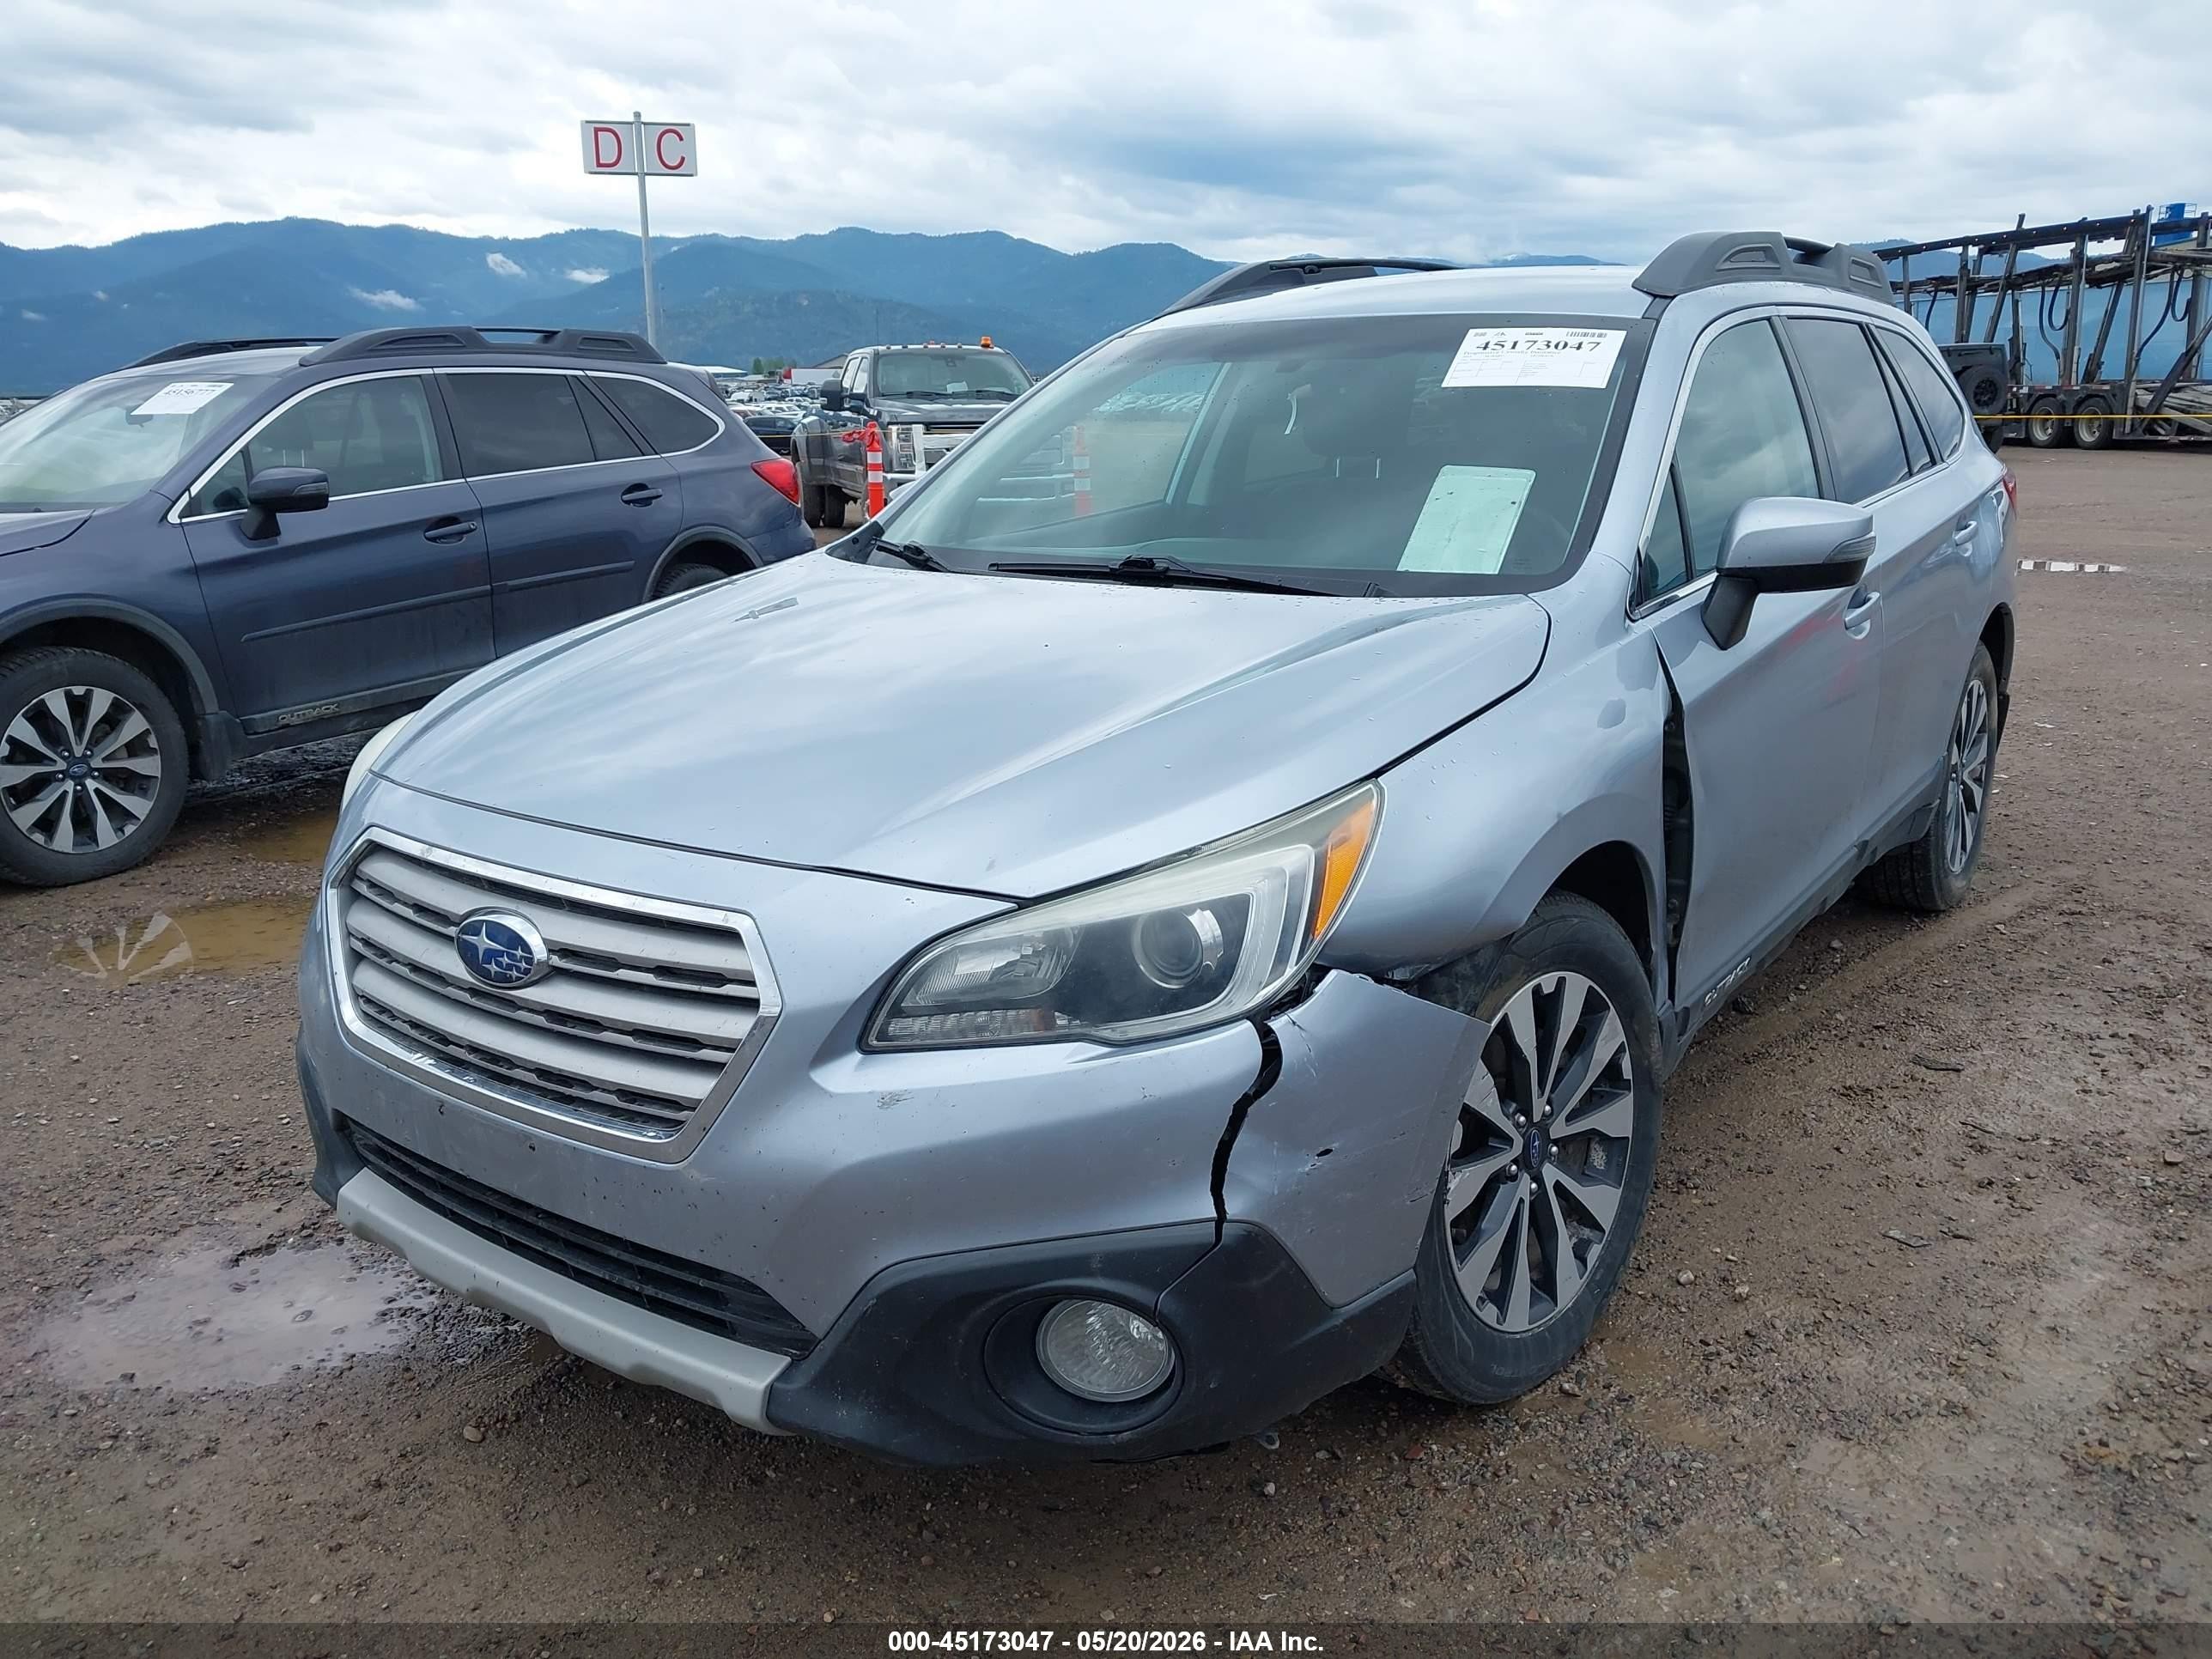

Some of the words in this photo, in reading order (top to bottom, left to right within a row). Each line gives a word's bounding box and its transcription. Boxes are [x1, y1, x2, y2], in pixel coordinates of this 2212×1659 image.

[592, 126, 623, 168] D
[656, 128, 686, 171] C
[1475, 339, 1602, 352] 45173047
